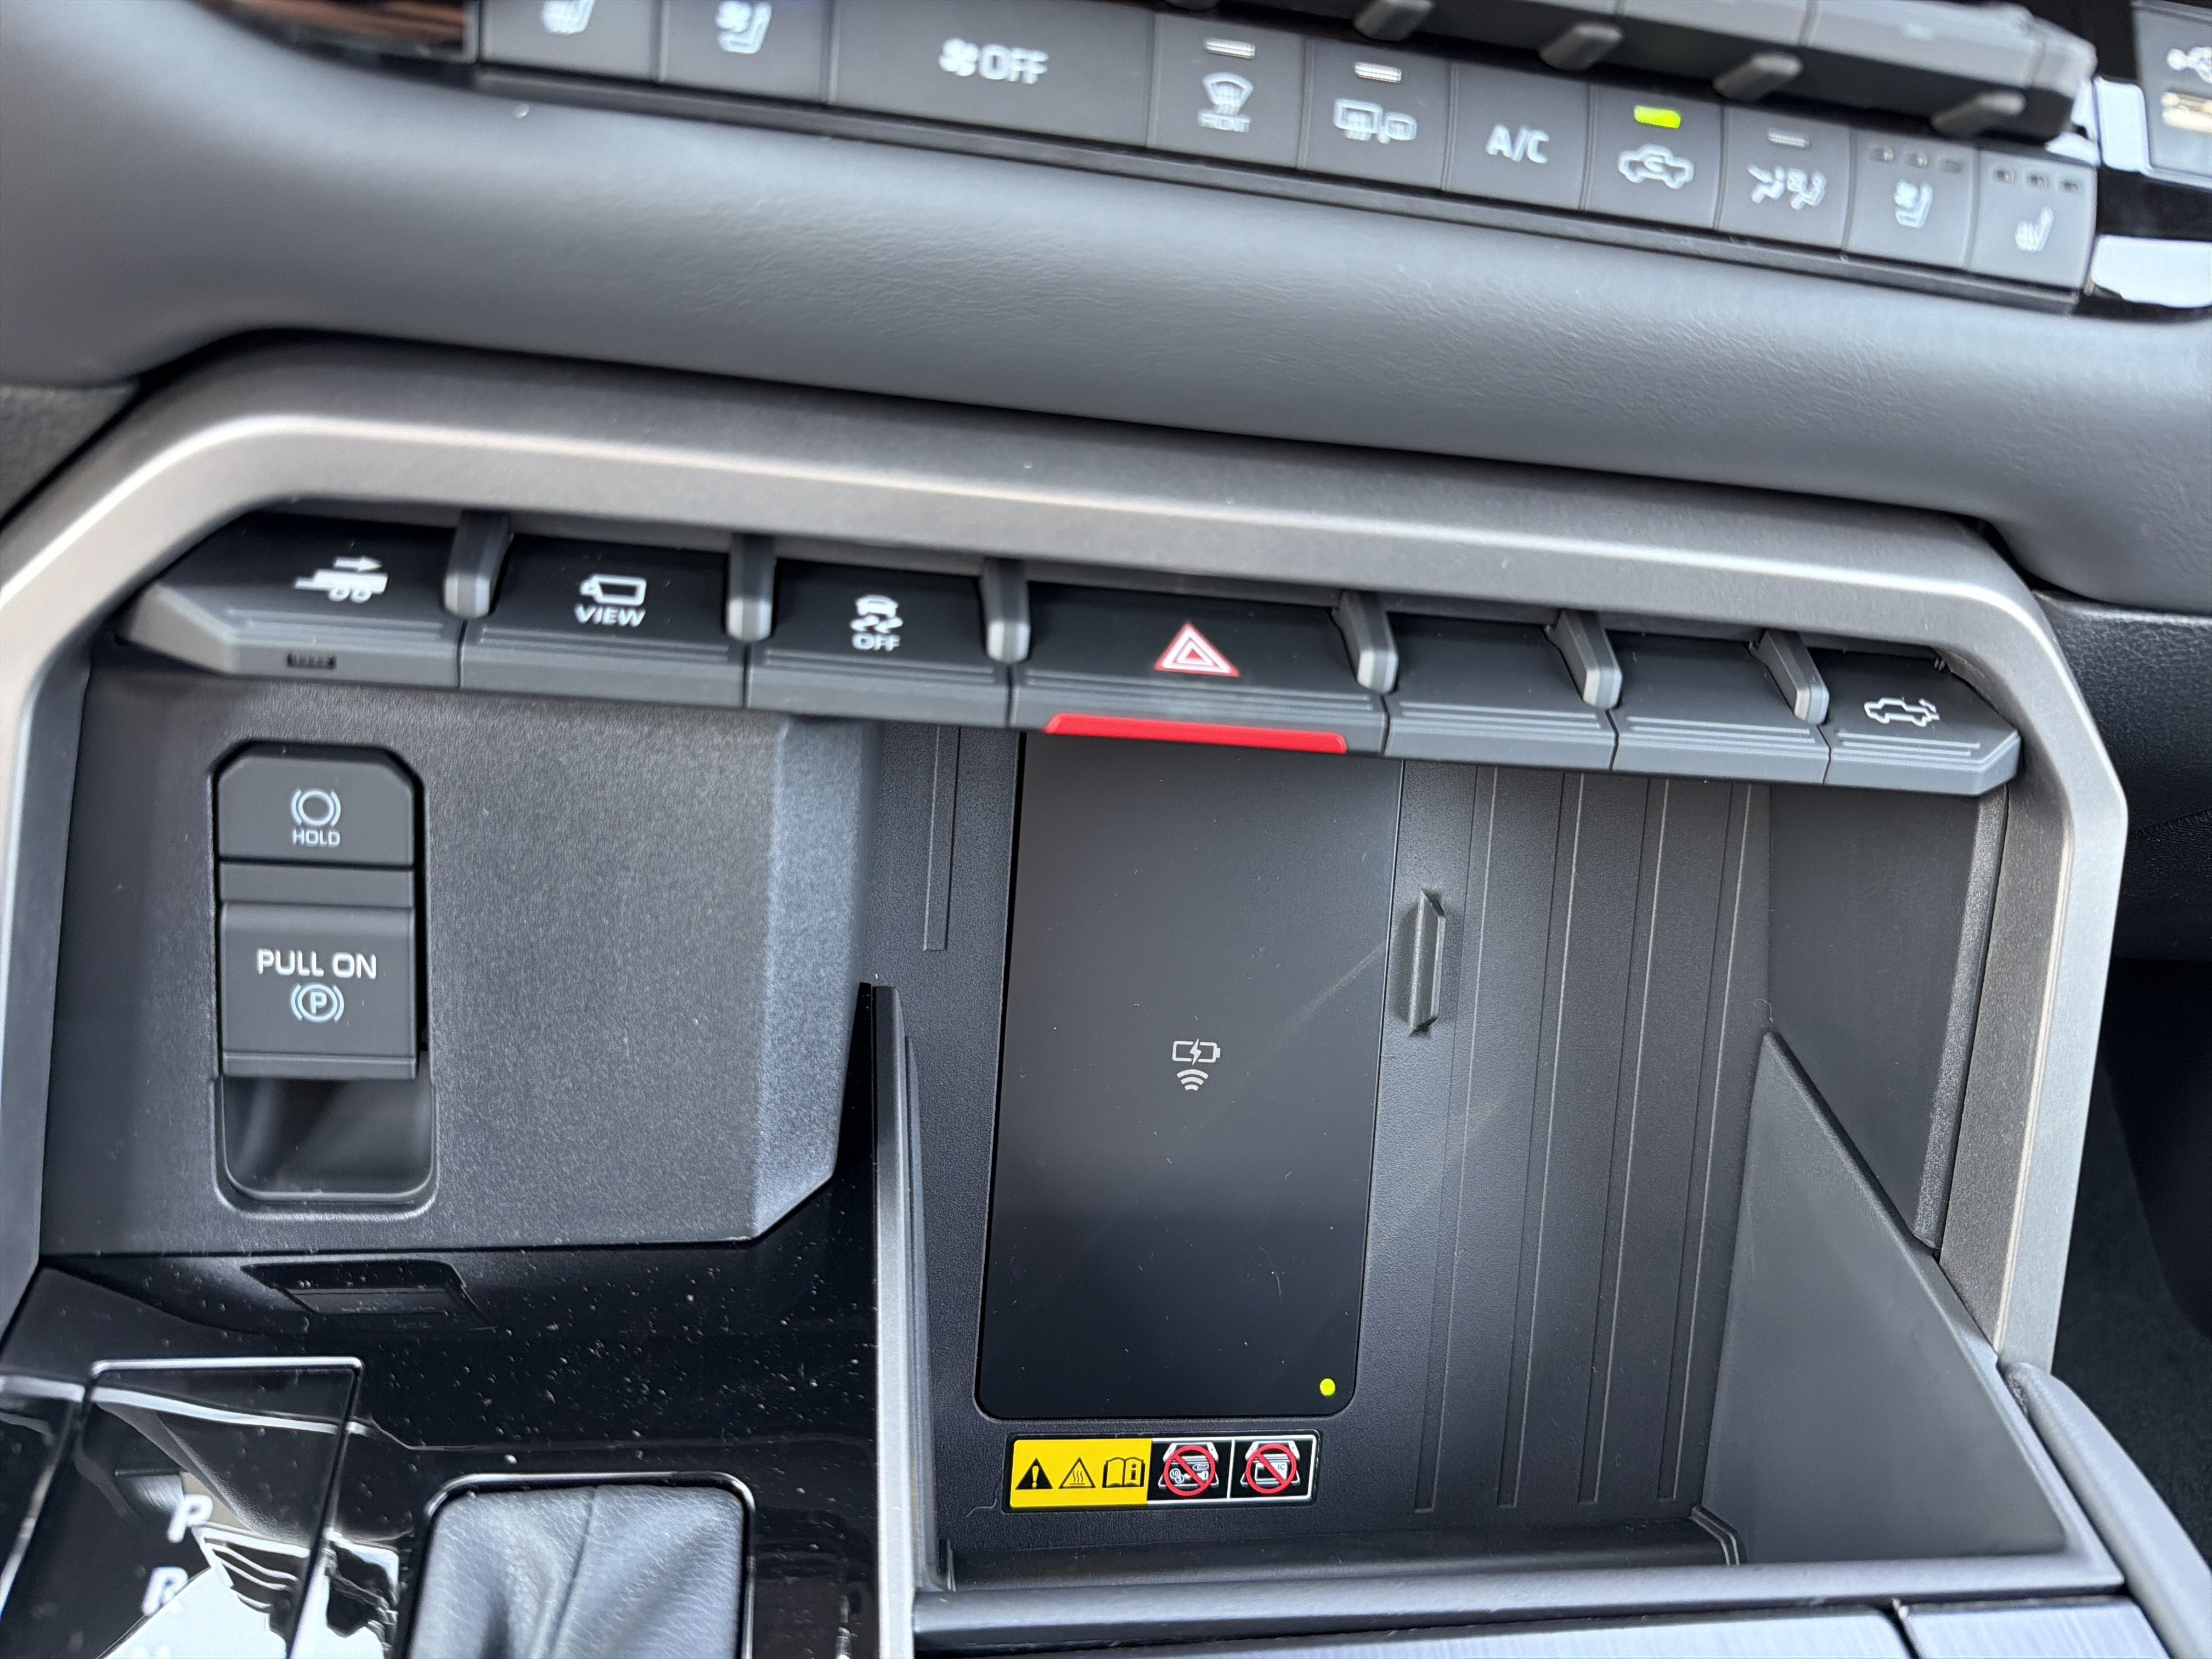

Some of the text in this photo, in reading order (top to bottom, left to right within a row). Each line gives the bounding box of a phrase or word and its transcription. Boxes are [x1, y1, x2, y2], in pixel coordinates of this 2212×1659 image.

[978, 43, 1049, 84] OFF
[1486, 123, 1550, 165] A/C
[574, 603, 646, 628] VIEW
[851, 632, 901, 652] OFF
[292, 828, 341, 847] HOLD
[257, 947, 377, 979] PULL ON
[310, 991, 328, 1015] P
[167, 1493, 213, 1543] P
